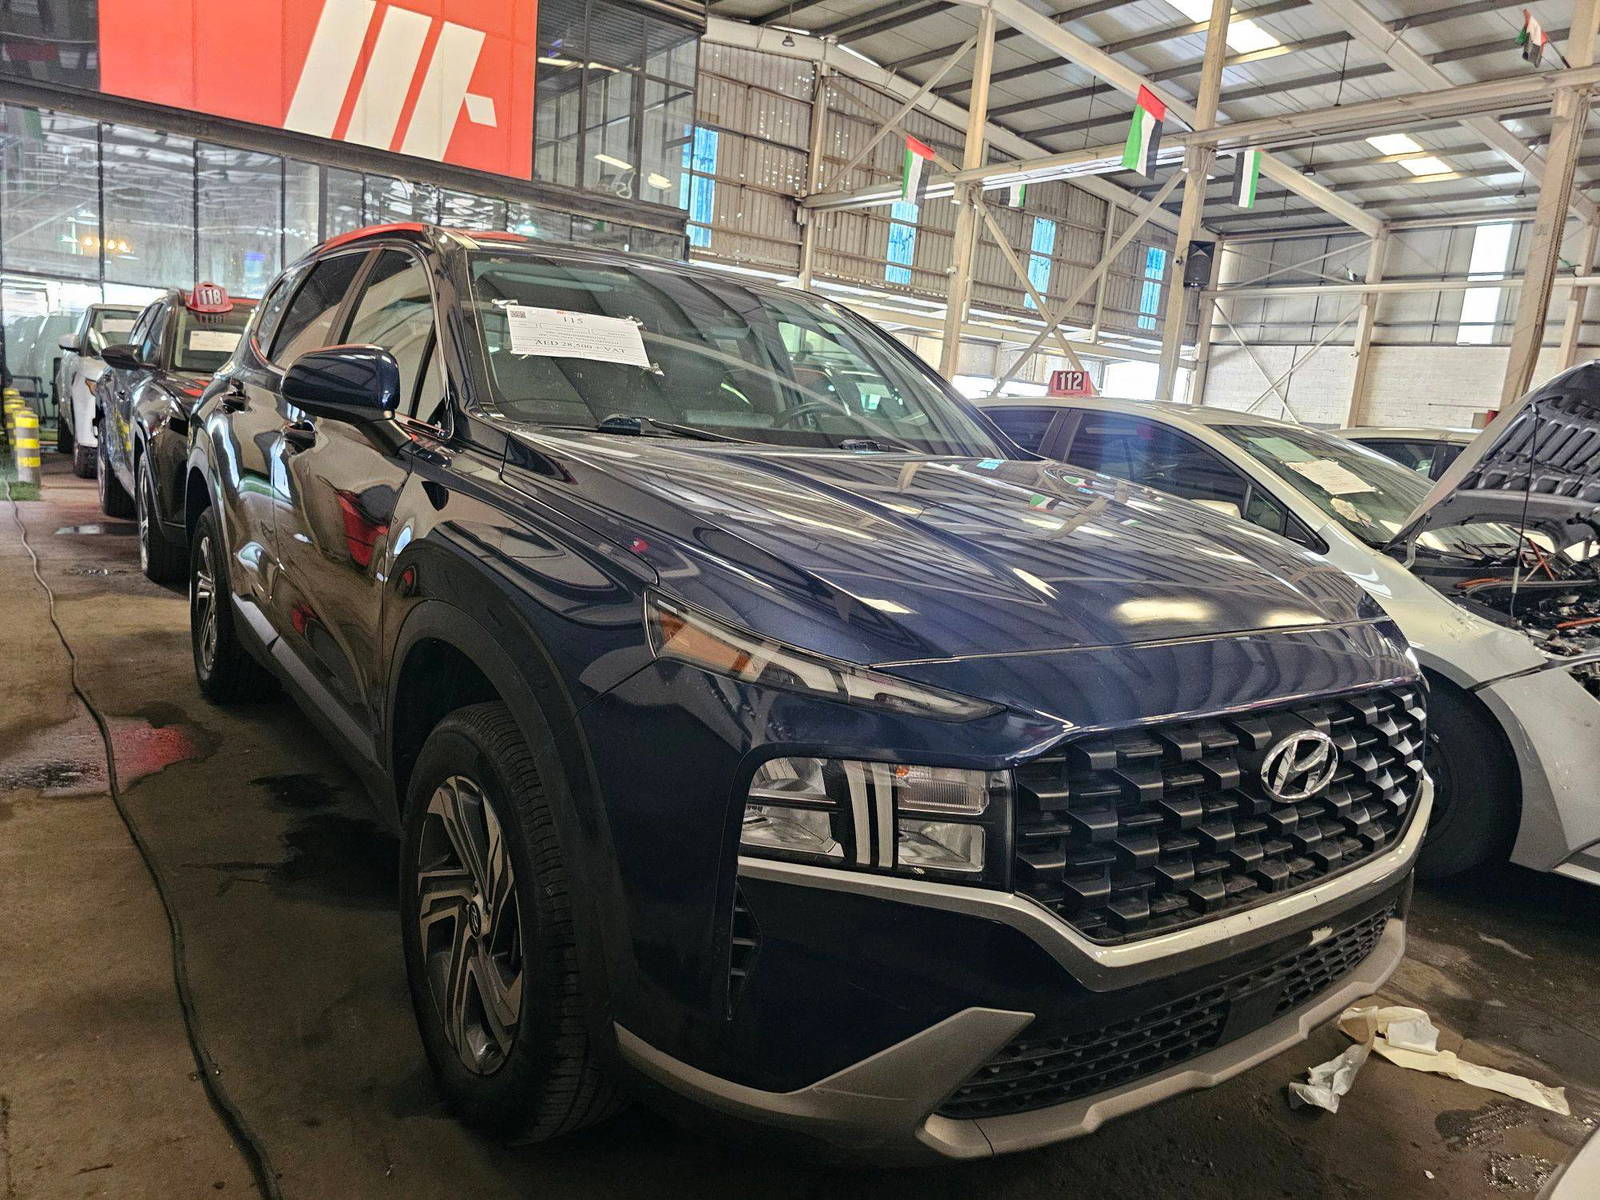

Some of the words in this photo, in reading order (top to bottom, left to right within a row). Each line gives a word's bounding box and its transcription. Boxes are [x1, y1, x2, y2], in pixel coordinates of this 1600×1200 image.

[201, 289, 221, 304] 118
[563, 316, 584, 324] 115
[535, 339, 559, 347] AED
[601, 346, 626, 354] VAT
[1059, 372, 1082, 390] 112
